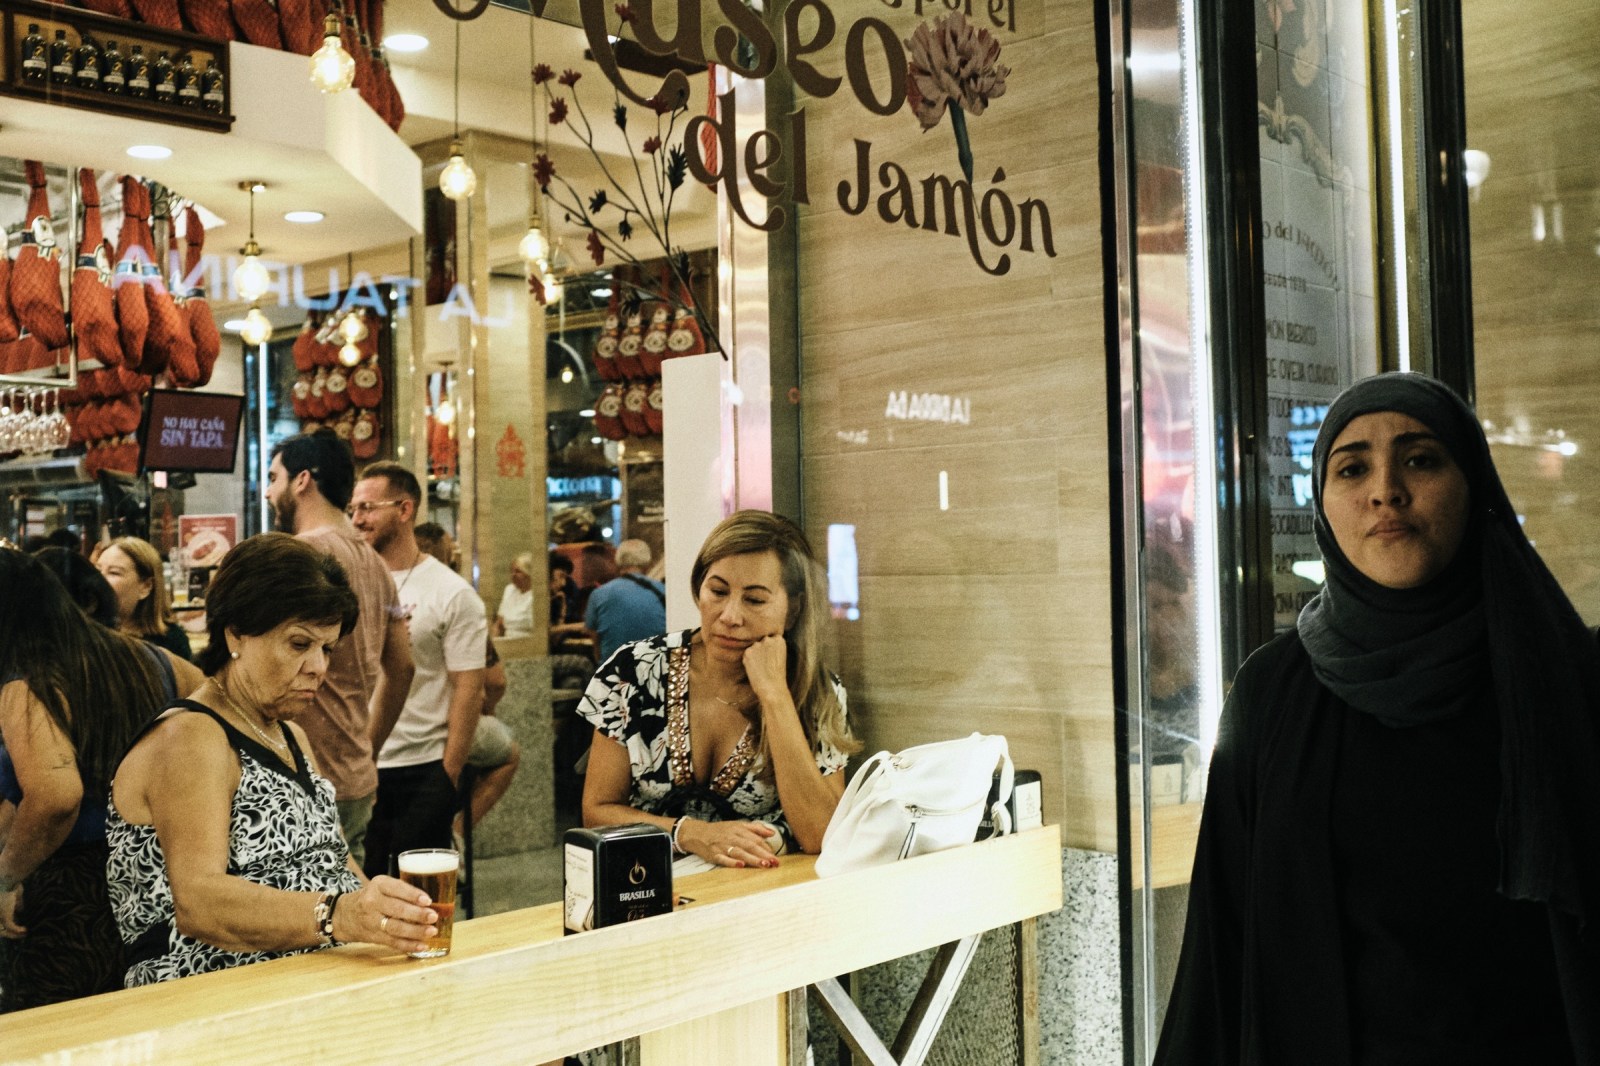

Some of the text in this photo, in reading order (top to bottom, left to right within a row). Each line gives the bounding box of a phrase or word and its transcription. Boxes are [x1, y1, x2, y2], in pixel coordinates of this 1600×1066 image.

[684, 88, 809, 231] del
[837, 138, 1057, 276] Jamón
[163, 417, 178, 428] NO
[180, 417, 198, 429] HAY
[161, 430, 223, 448] SIN TAPA
[619, 889, 656, 902] BRASILIA
